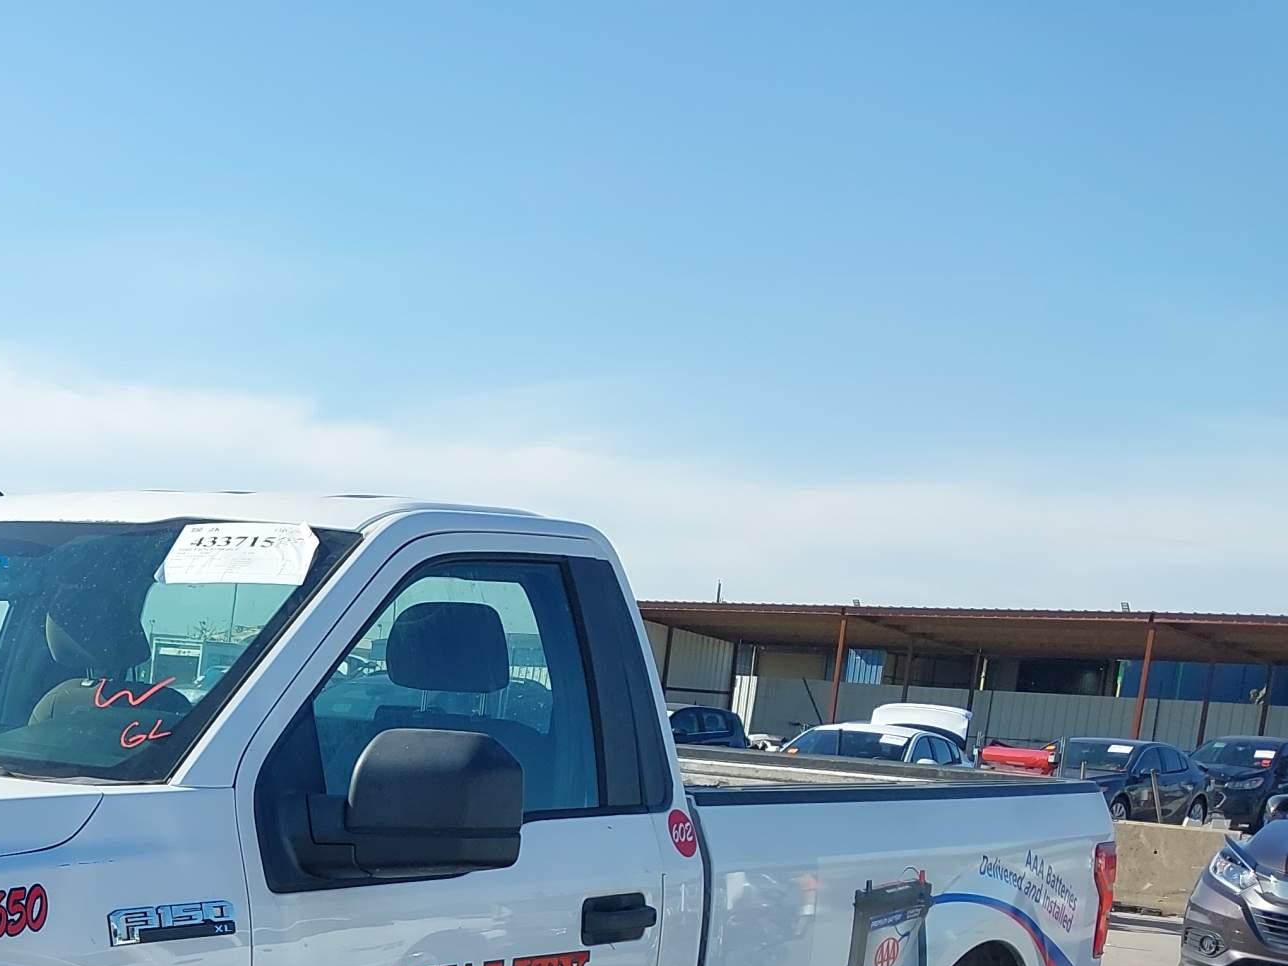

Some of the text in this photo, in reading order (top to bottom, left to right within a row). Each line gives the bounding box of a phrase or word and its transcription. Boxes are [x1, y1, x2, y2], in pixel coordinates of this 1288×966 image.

[190, 536, 305, 548] 433715
[672, 822, 693, 842] 602
[1025, 849, 1077, 911] AAA Batteries
[979, 855, 1073, 933] Delivered and Installed
[215, 924, 232, 934] XL
